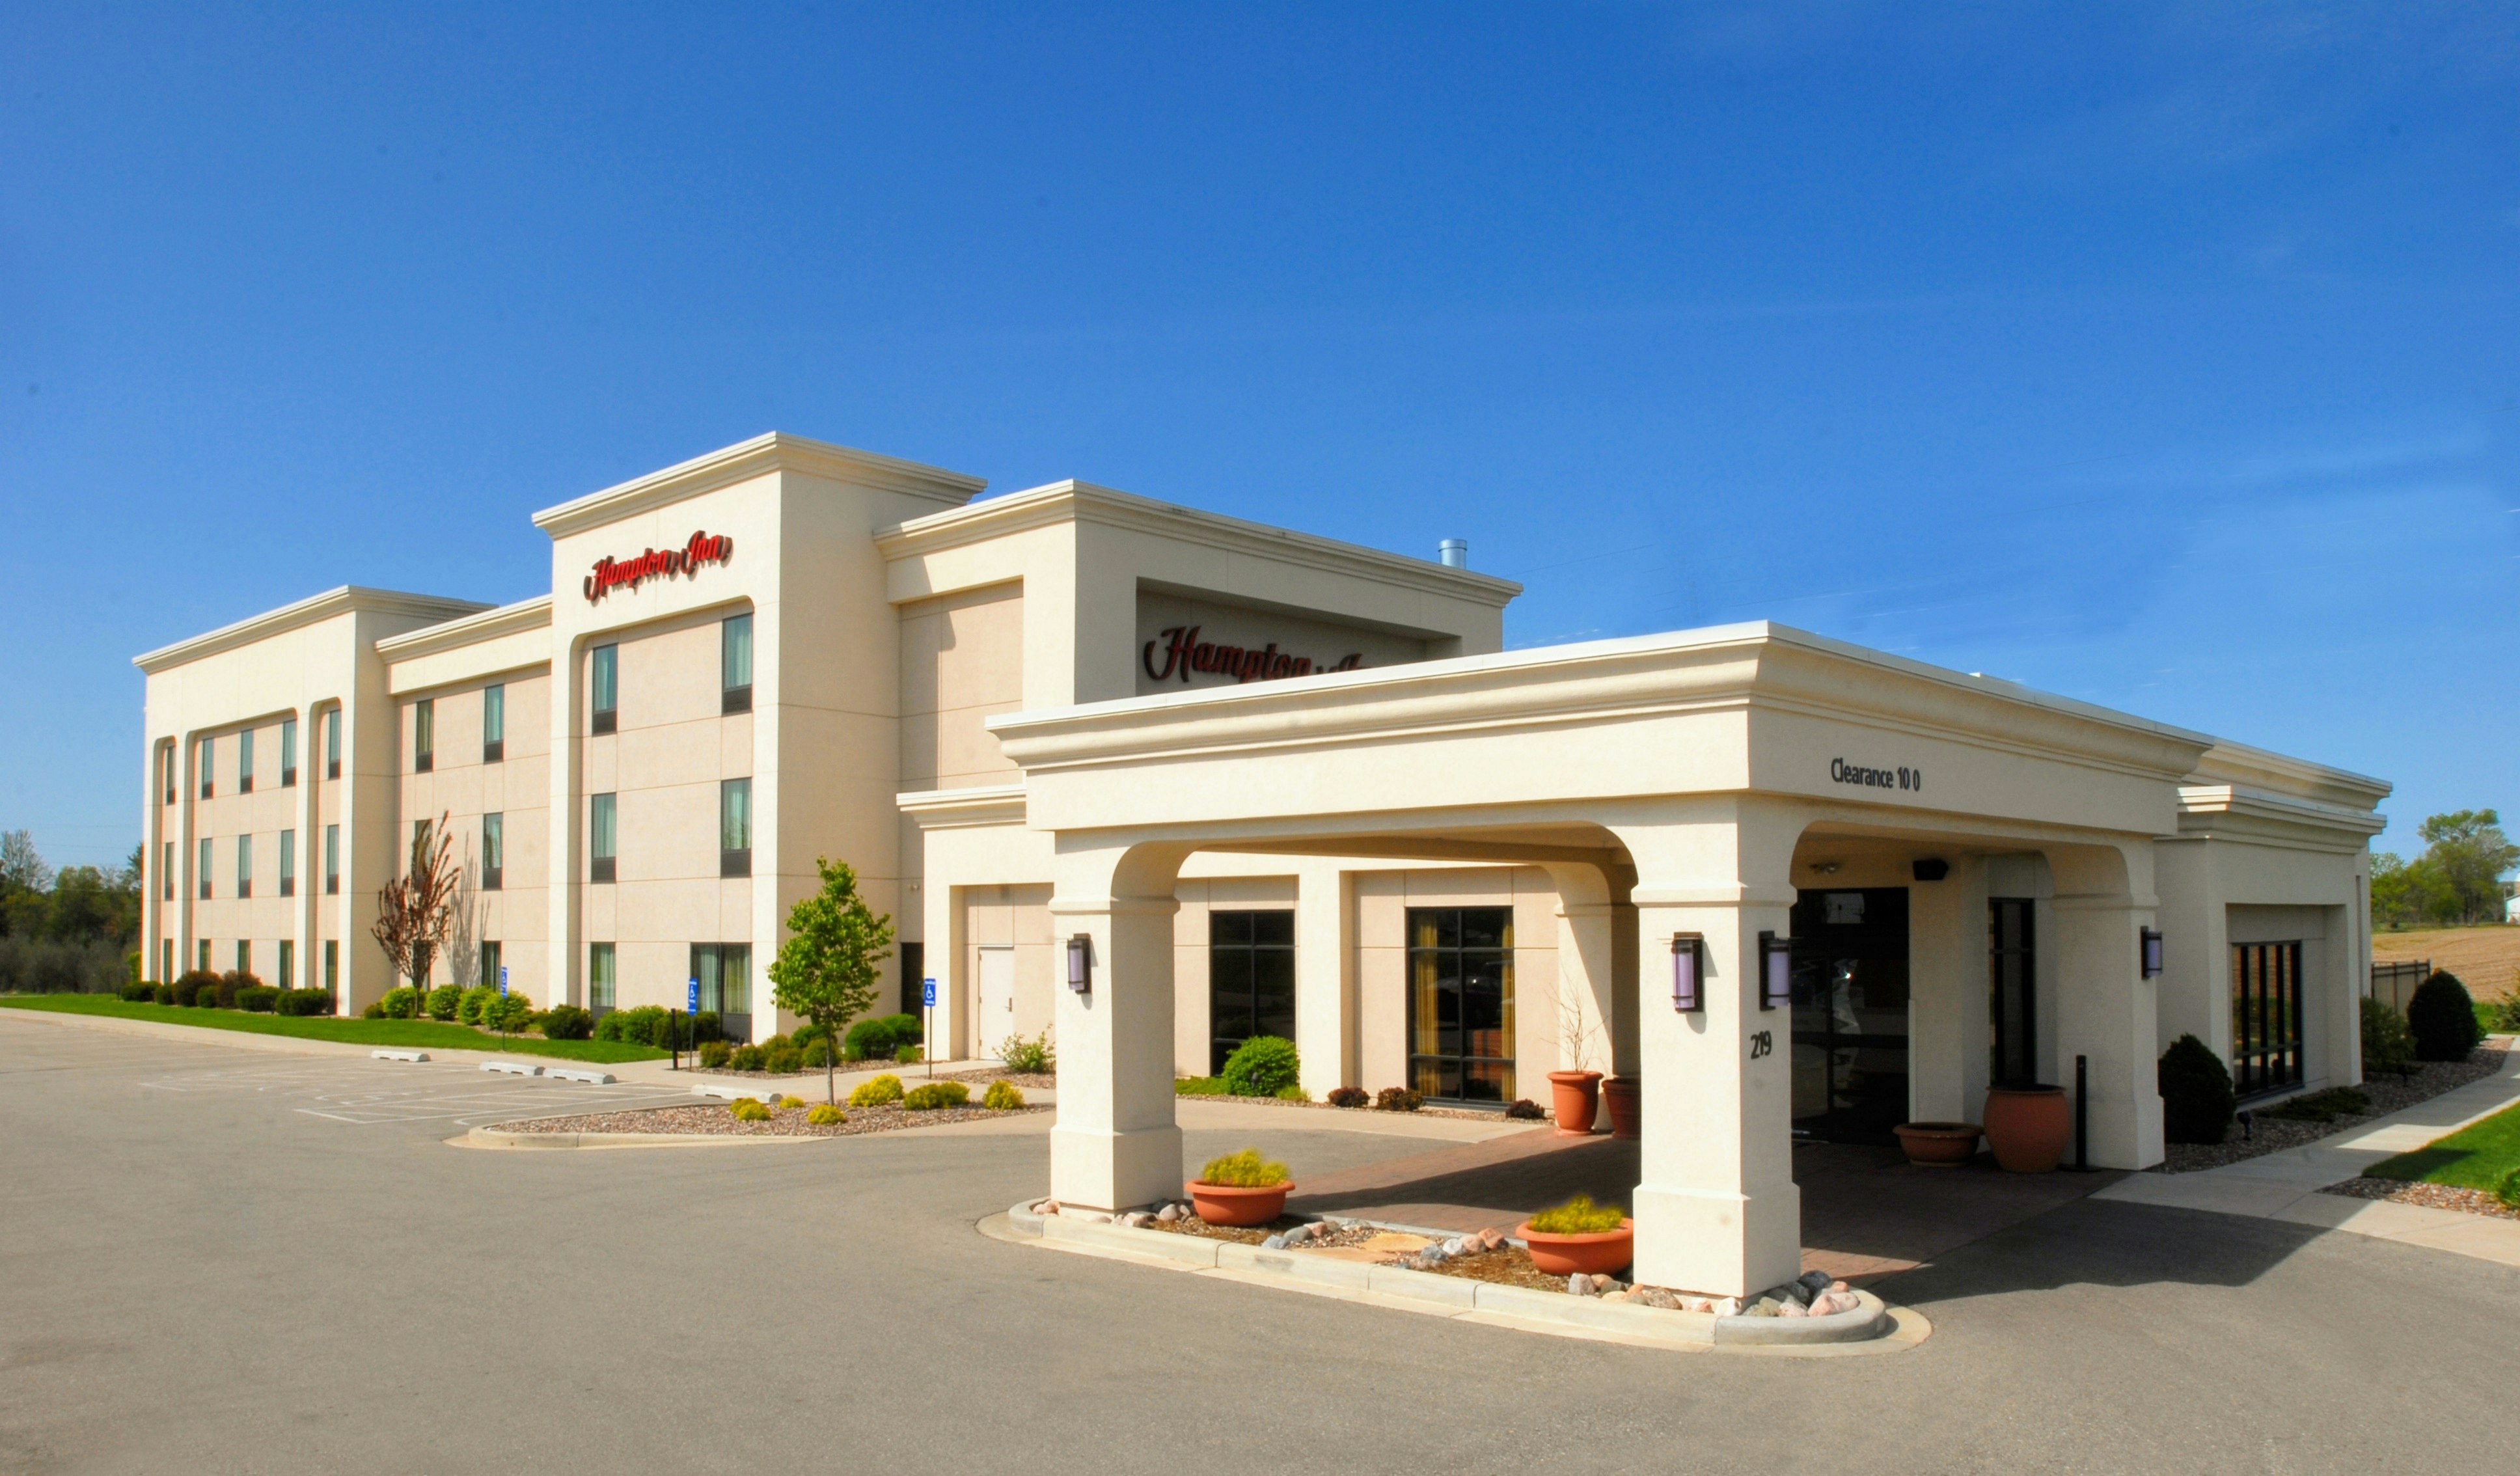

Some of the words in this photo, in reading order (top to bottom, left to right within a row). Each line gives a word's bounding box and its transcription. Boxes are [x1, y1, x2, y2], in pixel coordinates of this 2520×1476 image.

[583, 547, 679, 601] Hampton
[679, 530, 734, 575] Inn
[1144, 625, 1324, 683] Hampton
[1831, 757, 1894, 789] Clearance
[1750, 1030, 1772, 1059] 219
